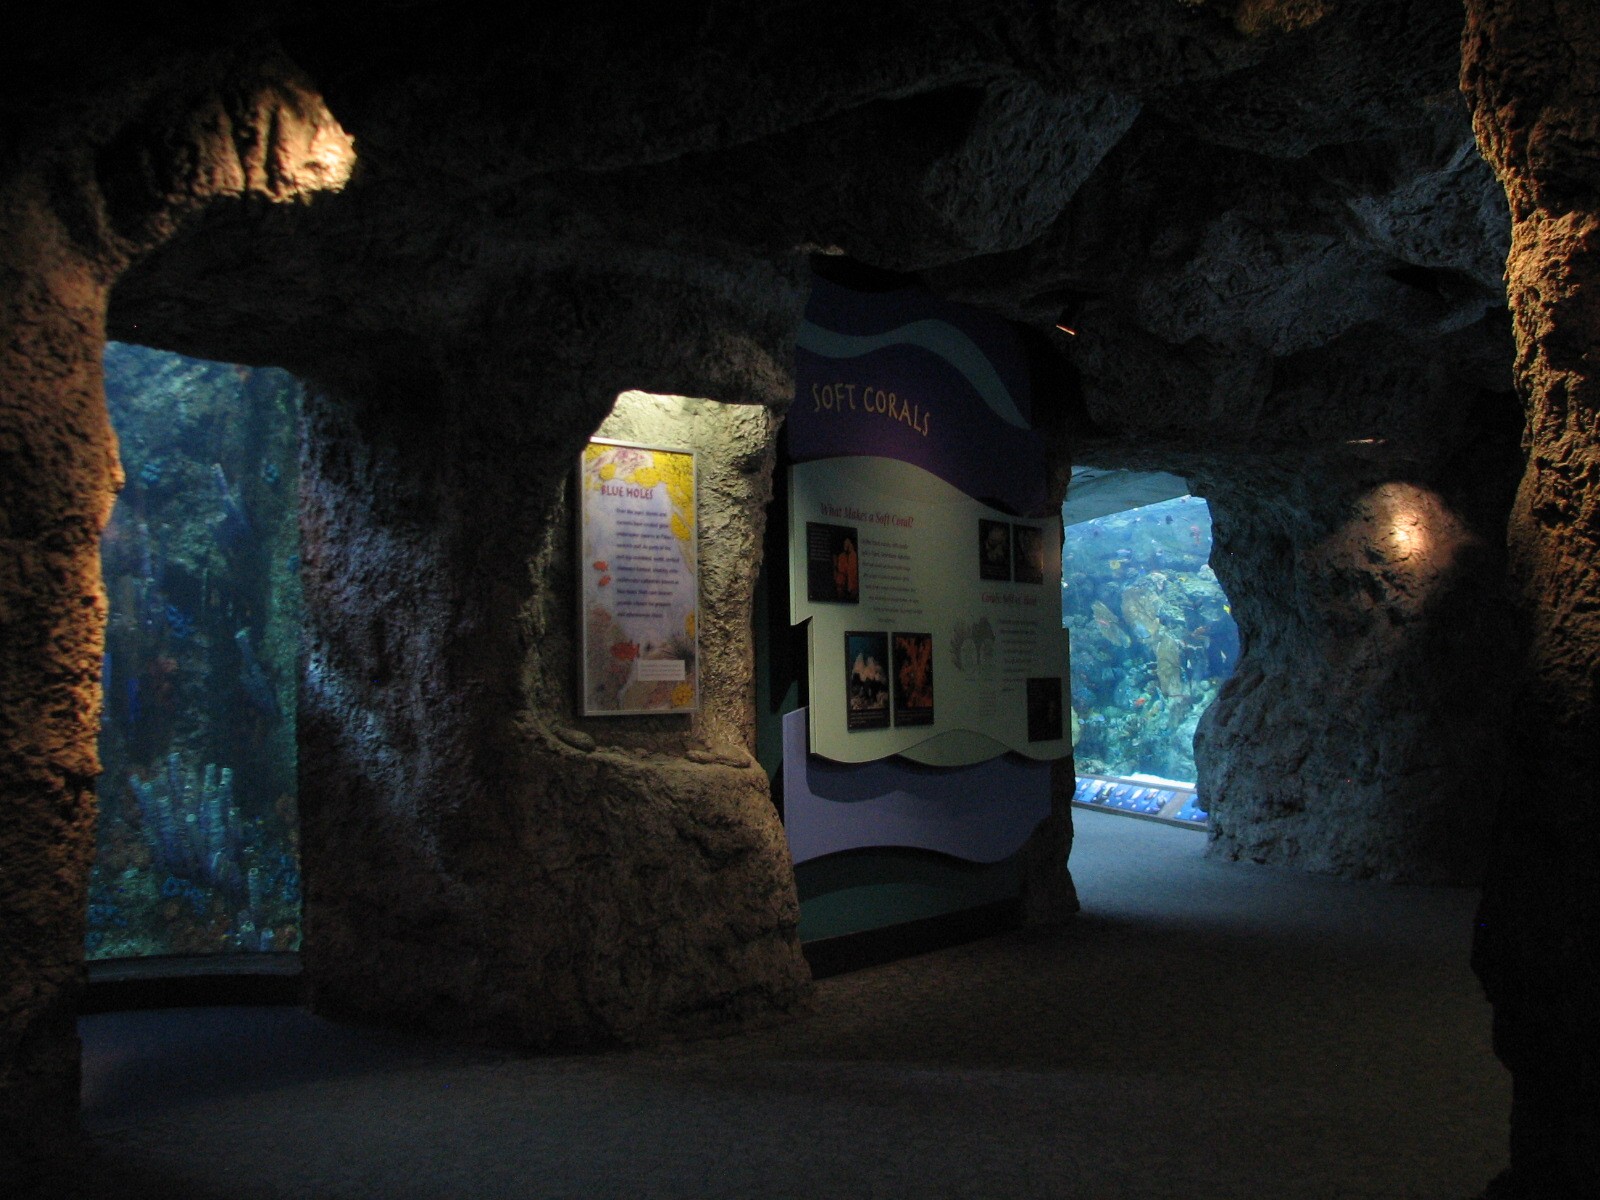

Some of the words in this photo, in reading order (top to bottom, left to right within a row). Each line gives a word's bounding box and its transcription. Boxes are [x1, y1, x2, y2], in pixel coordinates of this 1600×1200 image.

[812, 383, 856, 412] SOFT
[863, 386, 930, 437] CORALS
[601, 485, 624, 497] BLUE
[626, 488, 654, 499] HOLES
[820, 503, 842, 518] What
[844, 507, 868, 522] Makes
[875, 512, 890, 526] Soft
[891, 514, 914, 528] Coral?
